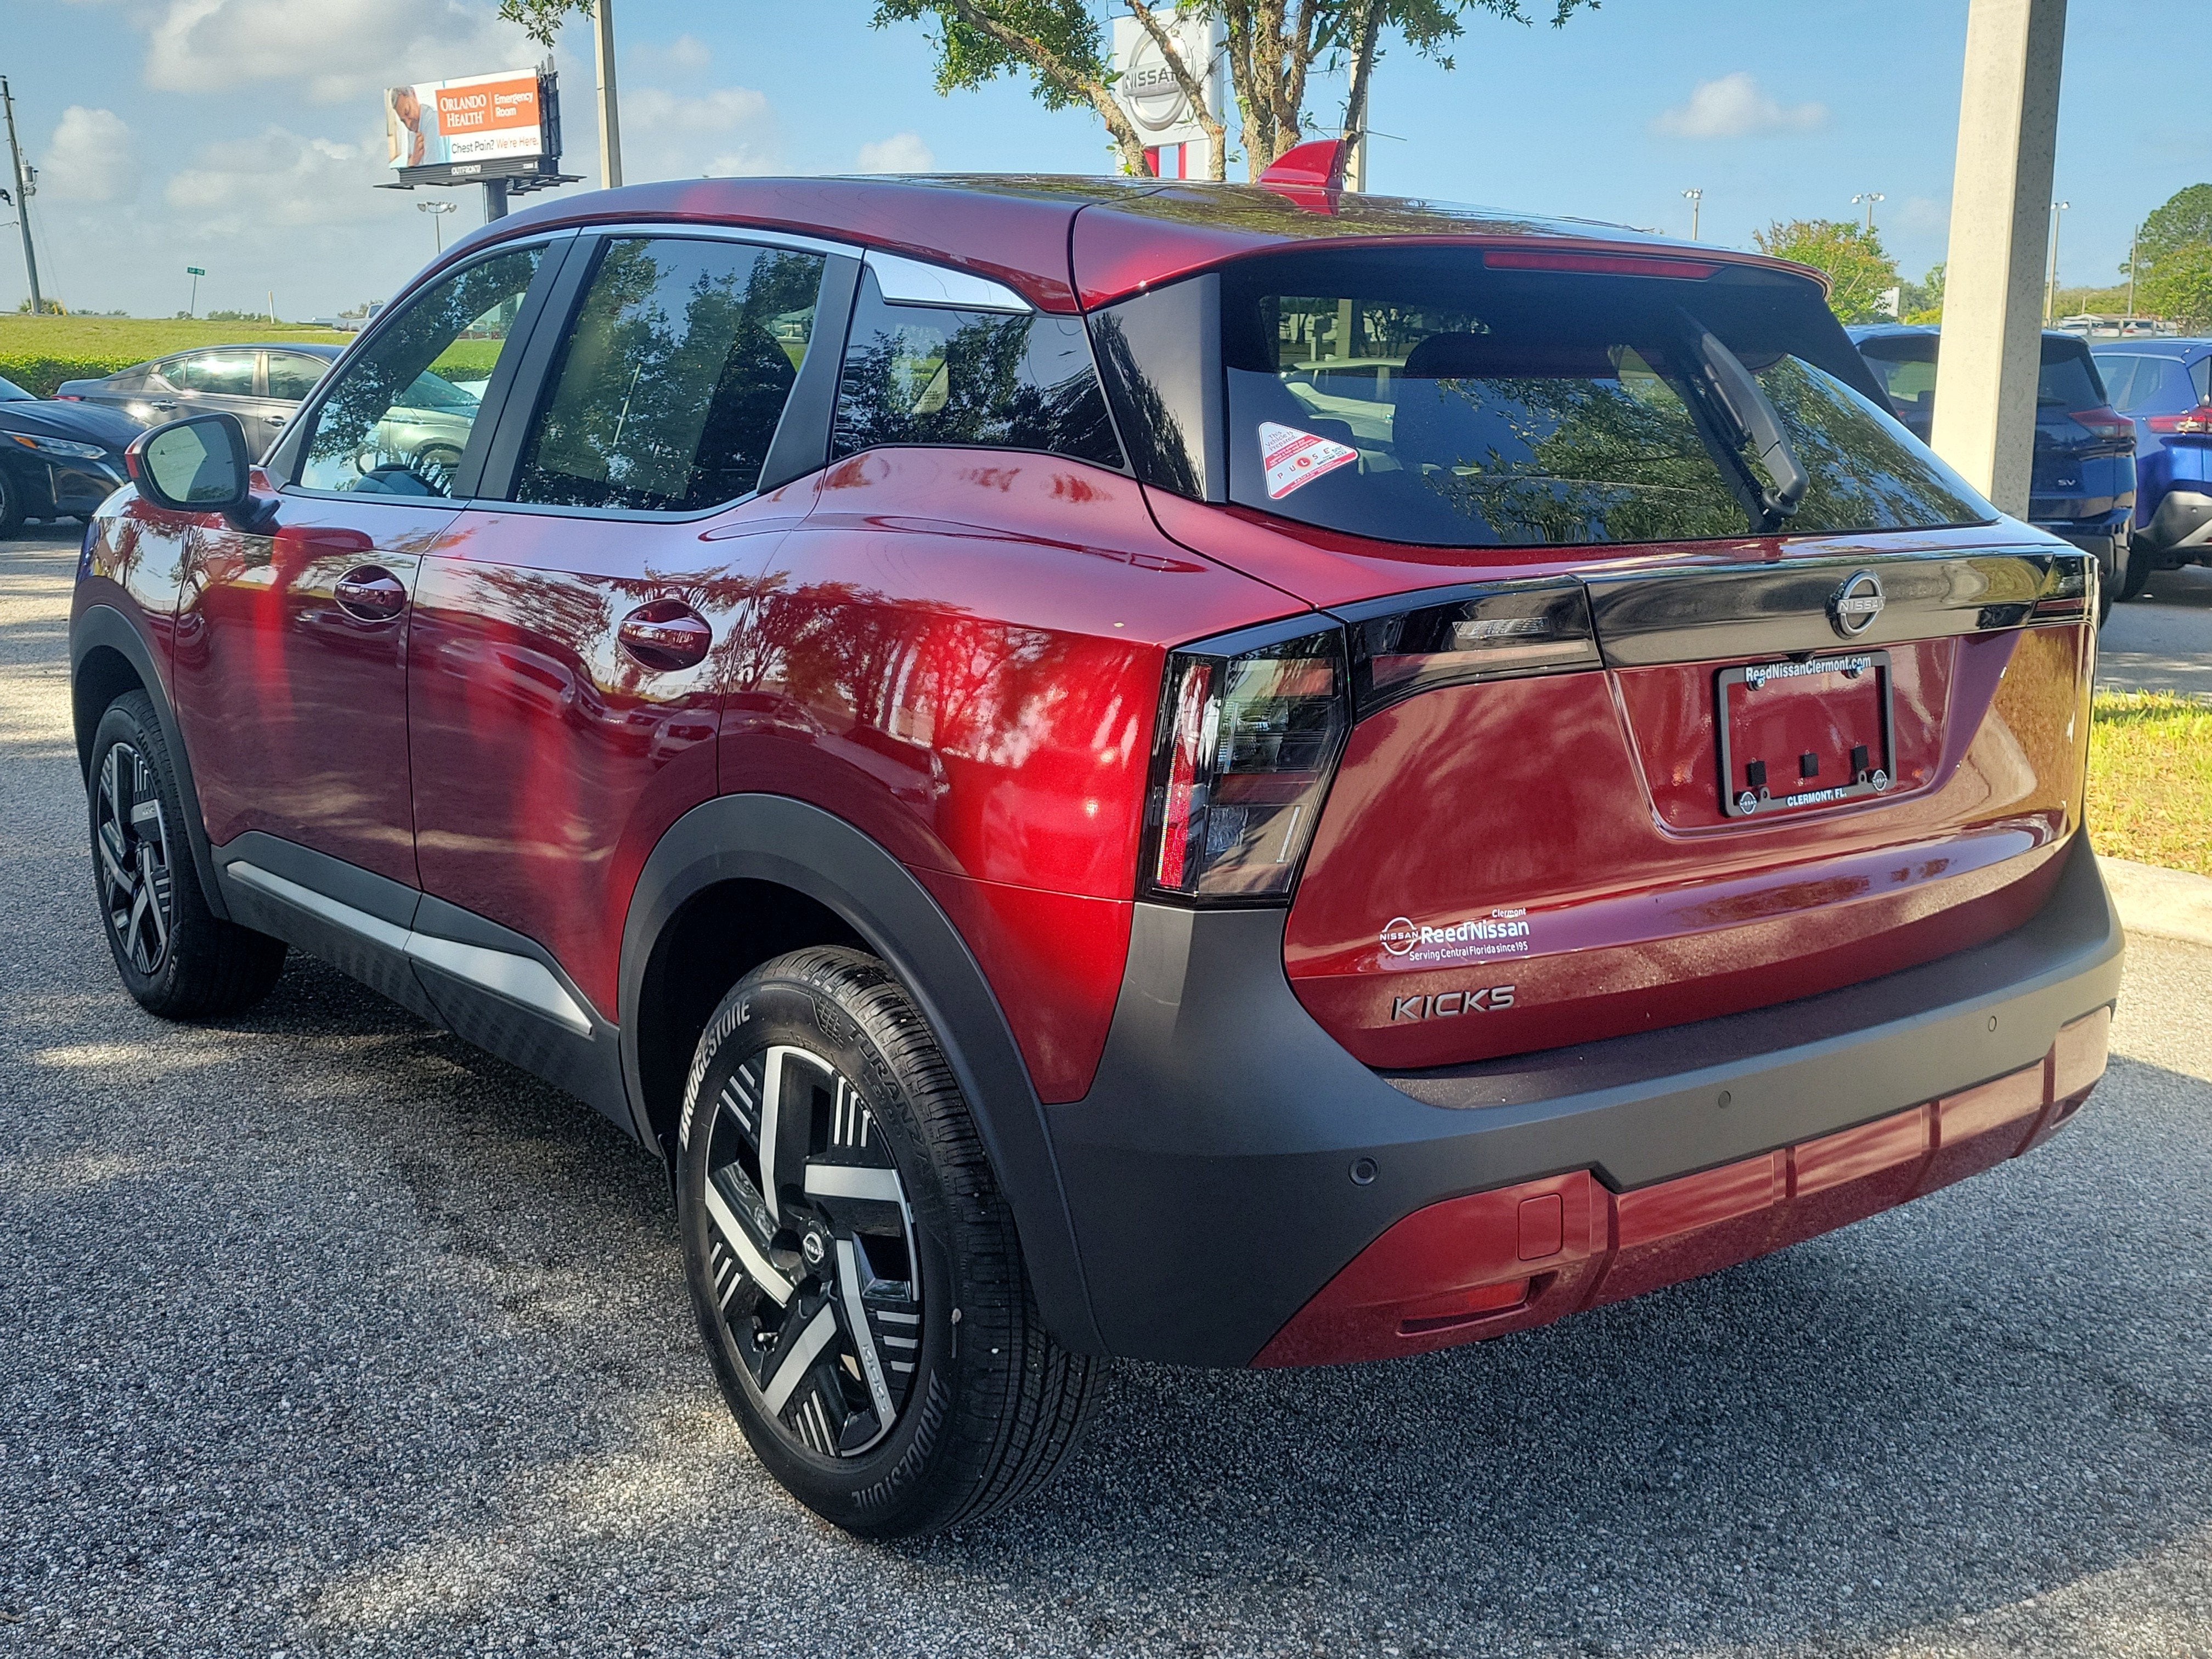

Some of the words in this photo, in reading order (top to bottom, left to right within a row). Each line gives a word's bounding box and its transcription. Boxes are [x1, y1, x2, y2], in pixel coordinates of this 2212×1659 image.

[440, 94, 487, 111] ORLANDO
[494, 92, 534, 104] Emergency
[446, 111, 484, 128] HEALTH
[495, 107, 517, 117] Room
[452, 142, 473, 154] Chest
[475, 139, 494, 151] Pain?
[496, 138, 517, 149] We're
[520, 137, 539, 146] Here.
[1839, 598, 1884, 612] NISSAN
[1745, 656, 1871, 682] ReedNissanClermont.com
[1787, 789, 1833, 806] CLERMONT,
[1835, 788, 1847, 798] FL.
[1492, 907, 1526, 918] Clermont
[1379, 930, 1419, 941] NISSAN
[1409, 950, 1441, 961] Serving
[1441, 946, 1469, 958] Central
[1469, 944, 1496, 956] Florida
[1496, 943, 1516, 953] since
[1516, 941, 1528, 951] 195
[1391, 985, 1515, 1021] KICKS
[679, 997, 751, 1152] BRIDGESTONE
[861, 1343, 889, 1413] KICKS
[851, 1368, 952, 1510] BRIDGESTONE
